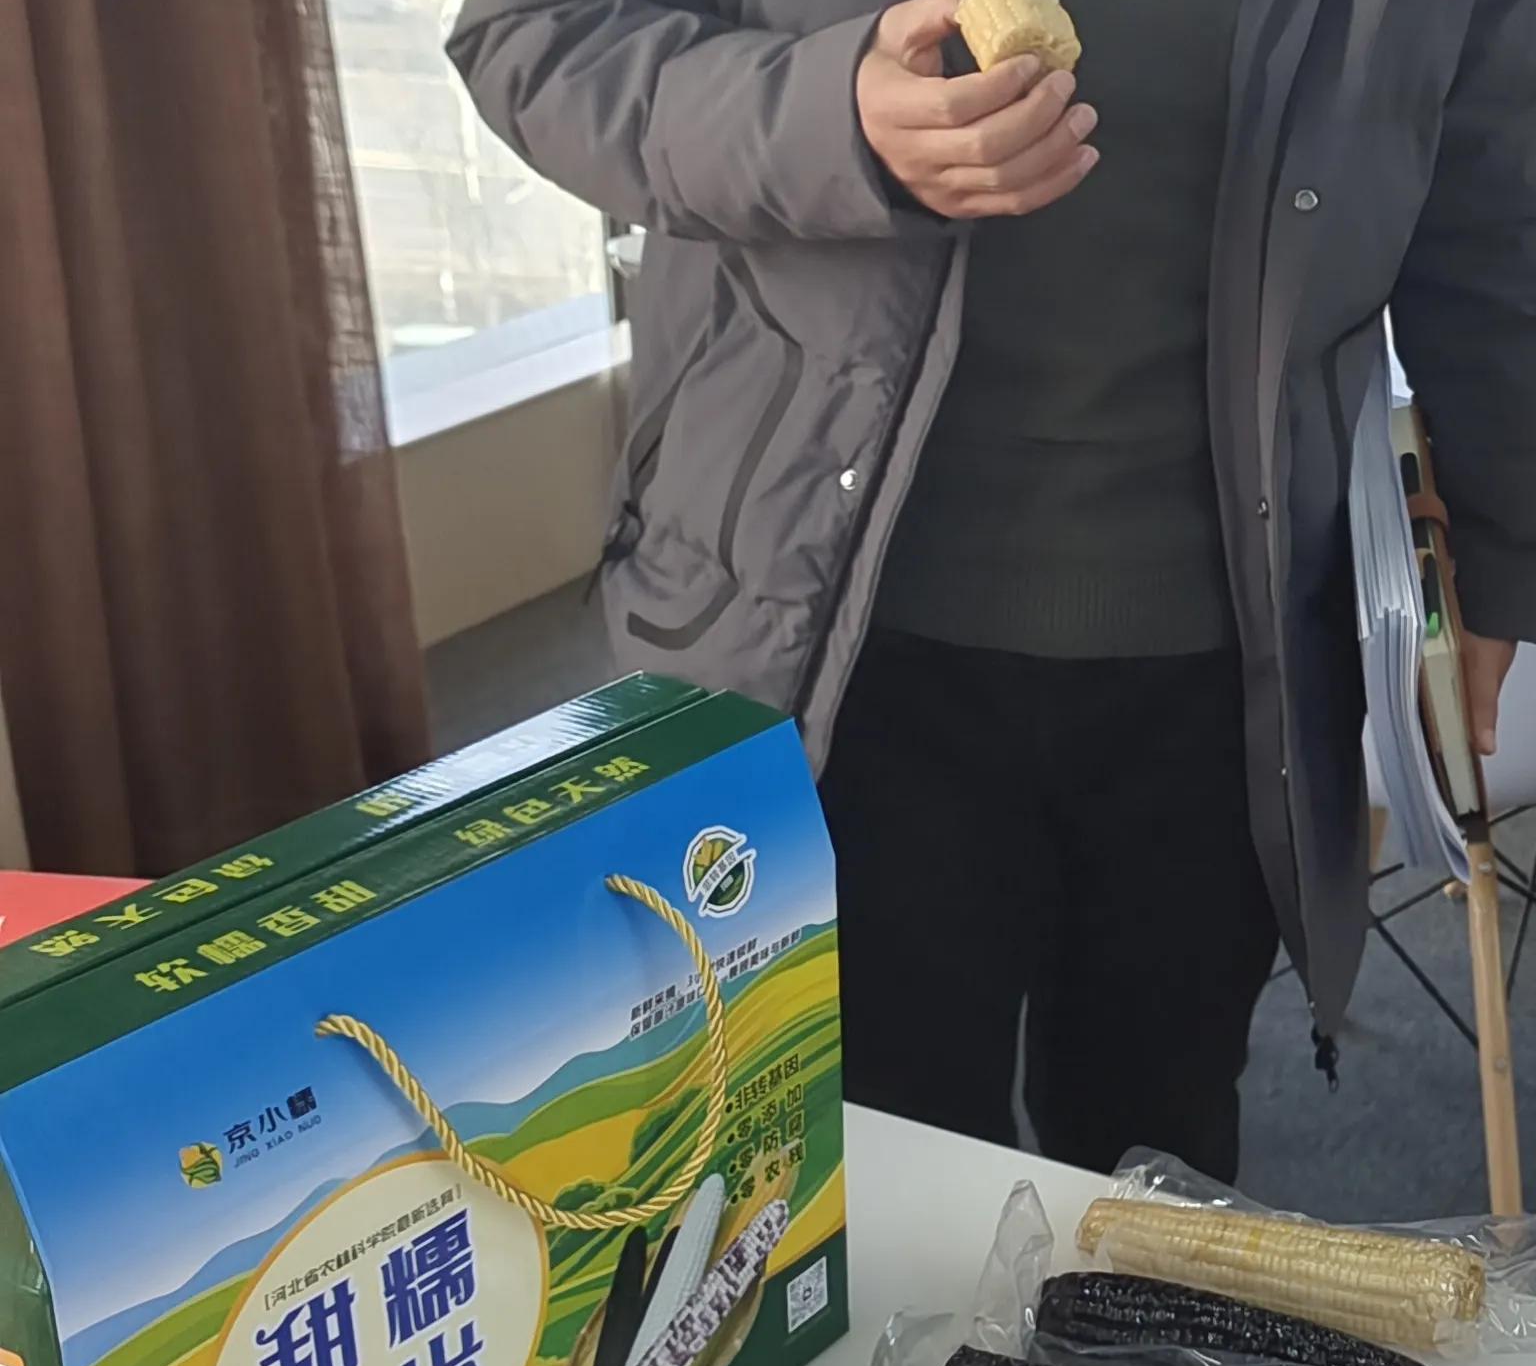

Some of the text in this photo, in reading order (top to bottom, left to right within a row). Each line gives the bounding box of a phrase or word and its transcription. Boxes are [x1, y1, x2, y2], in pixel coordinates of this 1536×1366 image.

[28, 853, 275, 957] 绿色天然
[134, 880, 378, 993] 软糯香甜
[454, 756, 651, 848] 绿色天然
[735, 1053, 800, 1110] 非转基因
[223, 1086, 317, 1154] 京小糯
[234, 1148, 260, 1169] JING
[298, 1115, 323, 1135] NUO
